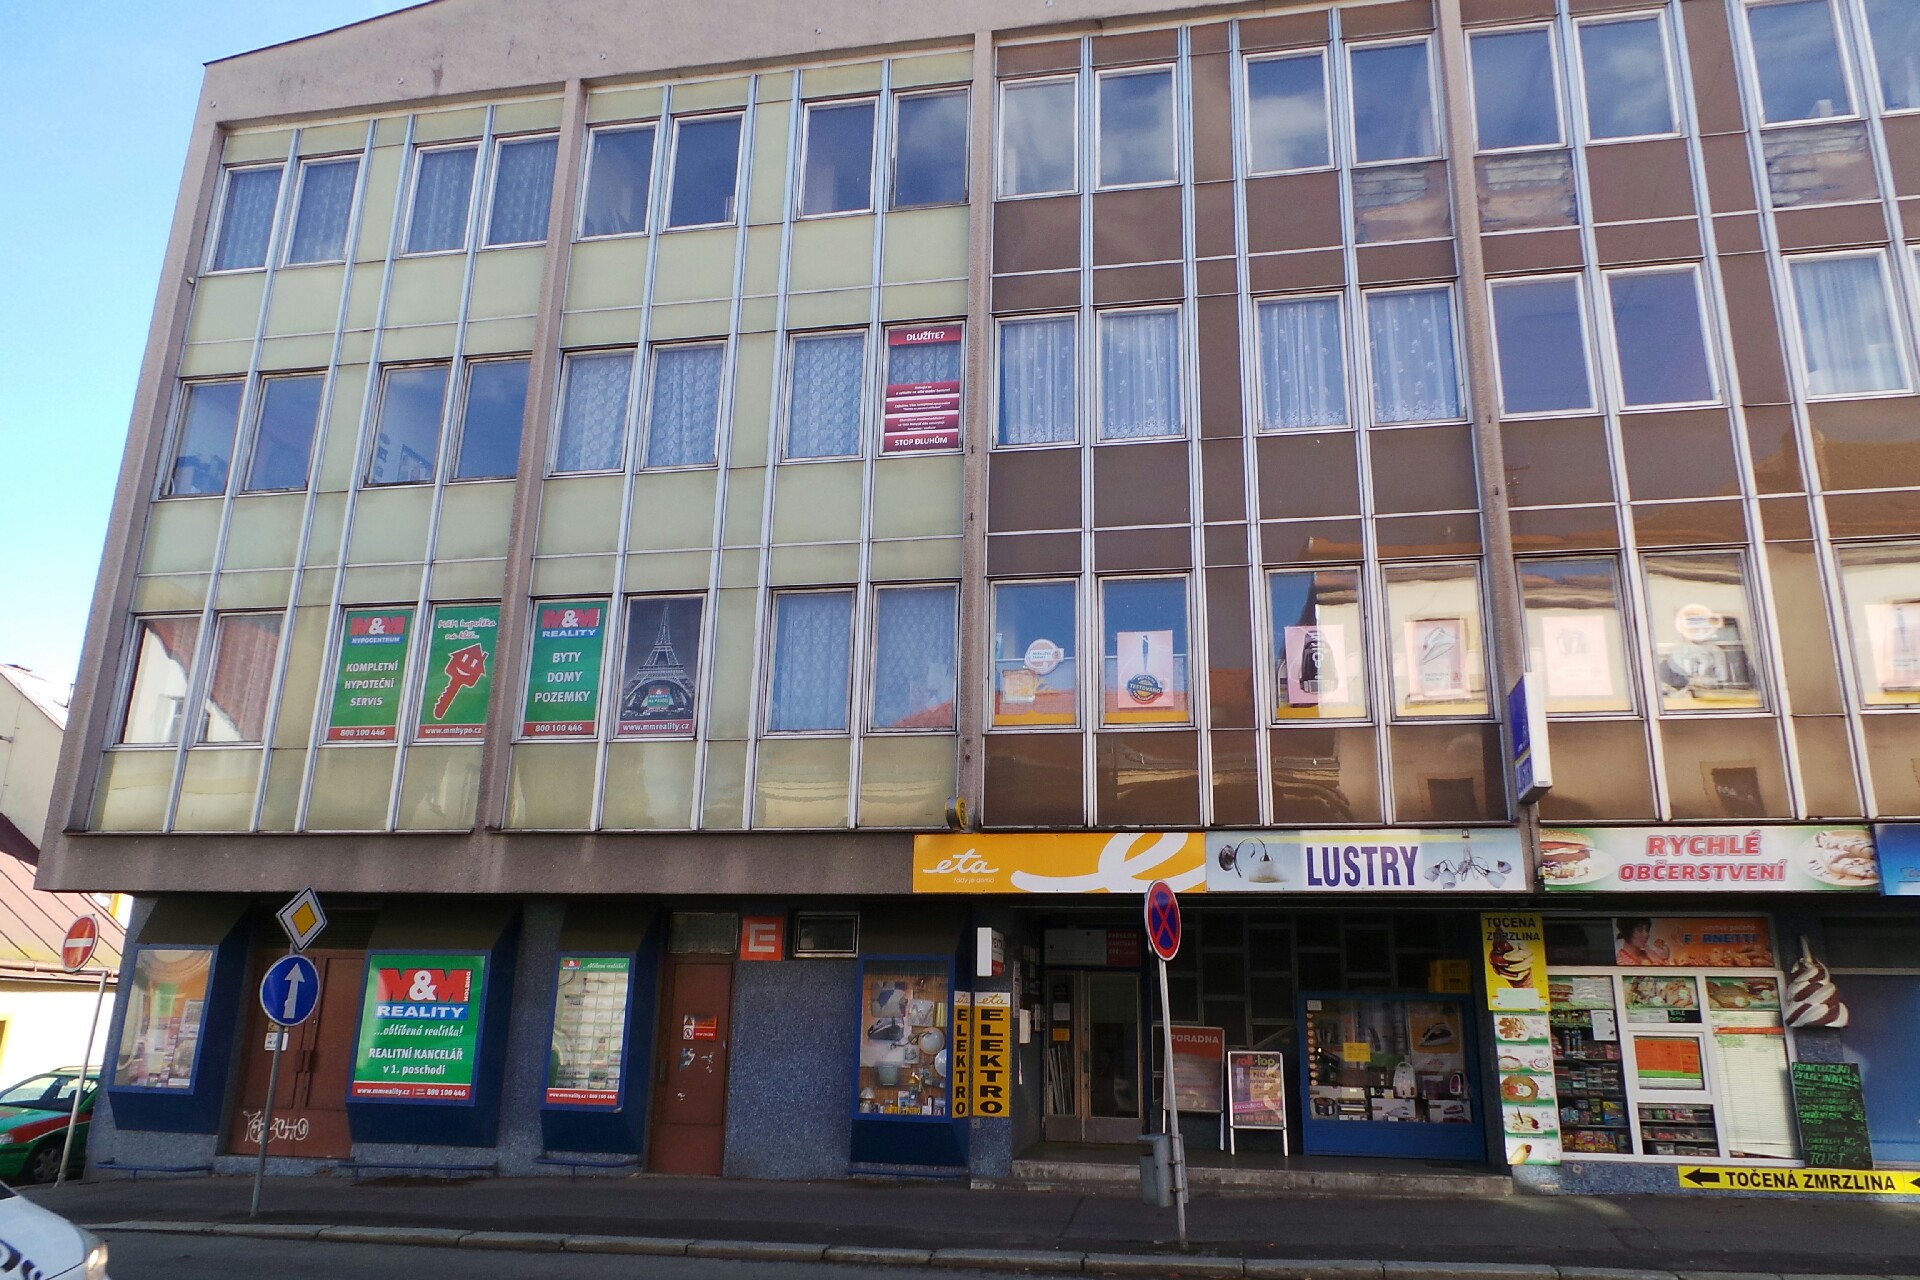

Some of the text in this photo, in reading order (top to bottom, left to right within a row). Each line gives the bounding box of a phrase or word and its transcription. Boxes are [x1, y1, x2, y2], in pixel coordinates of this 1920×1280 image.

[906, 331, 945, 341] DLUŽÍTE?
[894, 435, 948, 446] STOP DLUHŮM
[542, 608, 598, 628] M&M
[349, 616, 406, 636] M&M
[541, 629, 596, 637] REALITY
[552, 652, 581, 663] BYTY
[346, 660, 399, 672] KOMPLETNÍ
[547, 671, 583, 683] DOMY
[344, 678, 394, 689] HYPOTEČNÍ
[350, 697, 383, 706] SERVIS
[534, 691, 590, 703] POZEMKY
[340, 728, 386, 737] 800 100 446
[425, 728, 482, 736] www.mmhypo.cz
[535, 723, 583, 732] 800 100 446
[622, 722, 689, 732] www.mmreality.cz
[1645, 829, 1763, 857] RYCHLÉ
[923, 848, 999, 874] eta
[1307, 846, 1418, 888] LUSTRY
[1618, 859, 1788, 882] OBČERSTVENÍ
[1486, 931, 1541, 941] ZRZLINA
[1683, 933, 1760, 944] FRNETTI
[376, 968, 471, 1002] M&M
[976, 994, 1008, 1005] eta
[376, 1006, 464, 1018] REALITY
[424, 1025, 464, 1037] realitka!
[1170, 1034, 1219, 1044] PORADNA
[369, 1047, 463, 1060] REALITNÍ KANCELÁŘ
[955, 1009, 967, 1115] ELEKTRO
[980, 1009, 1003, 1114] ELEKTRO
[390, 1065, 399, 1073] 1.
[1725, 1170, 1896, 1190] TOČENÁ ZMRZLINA
